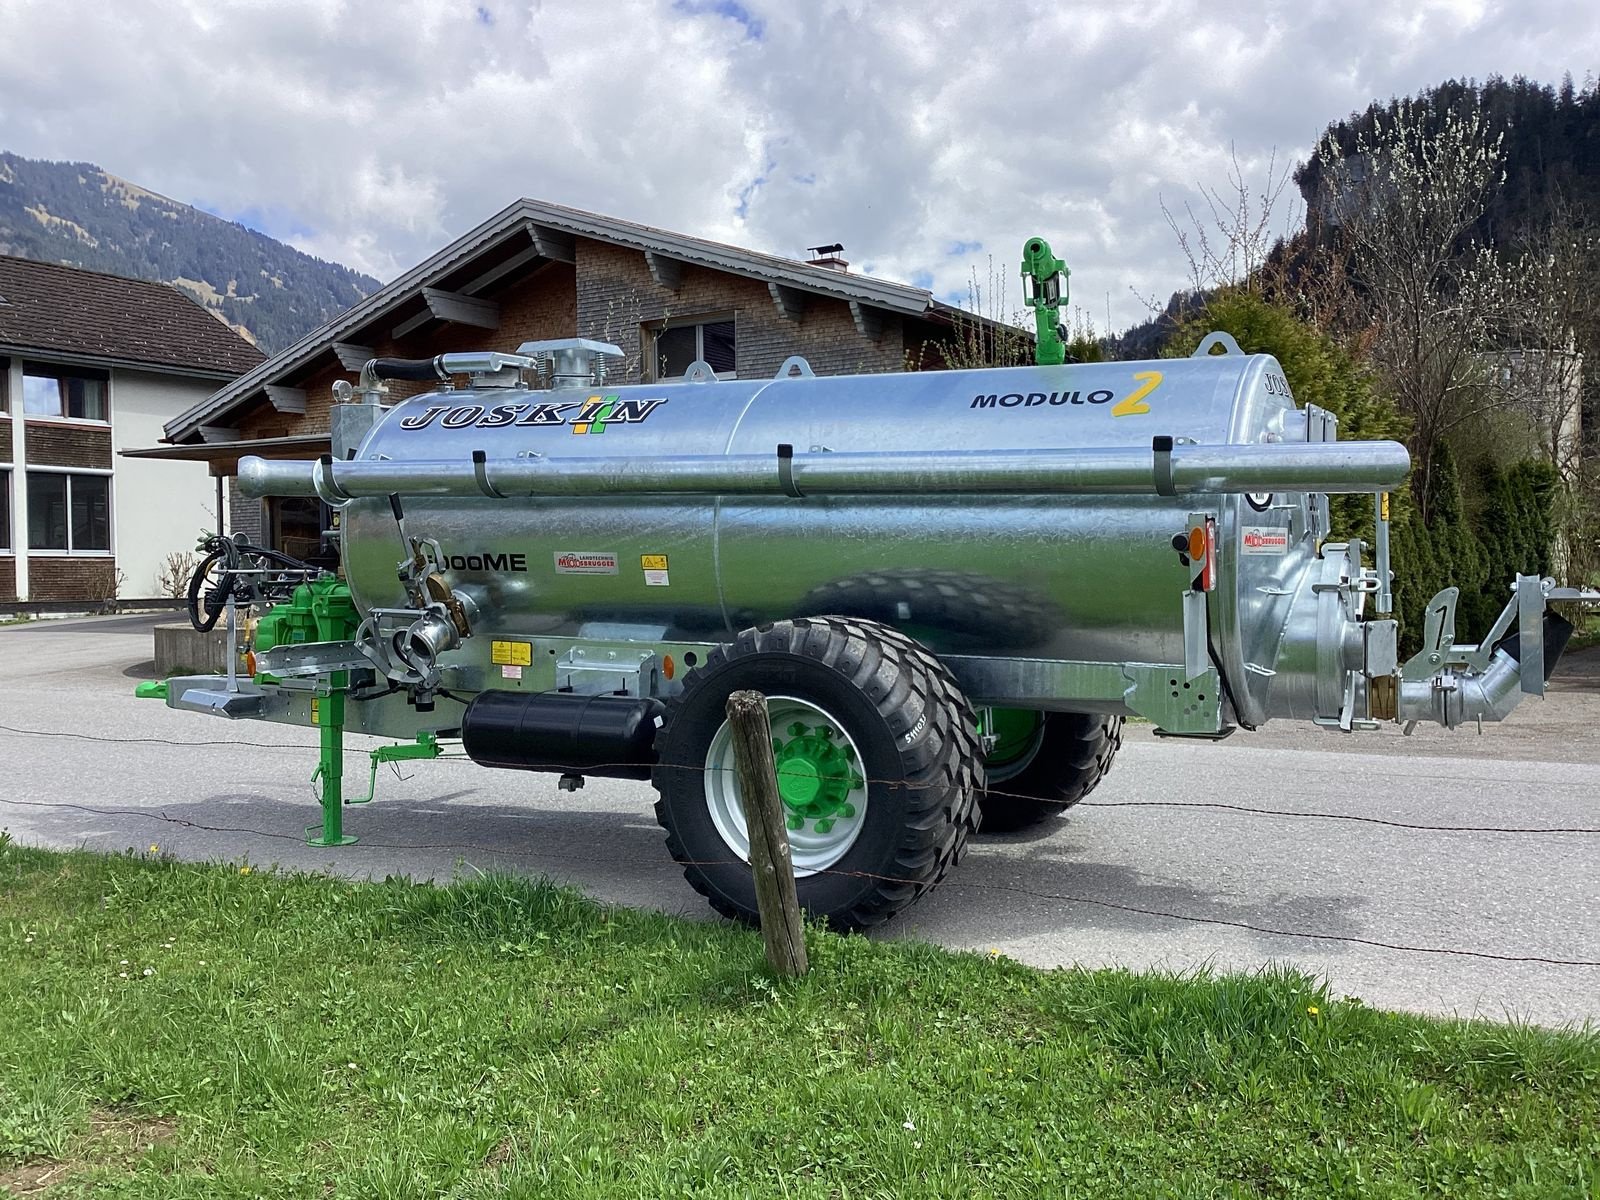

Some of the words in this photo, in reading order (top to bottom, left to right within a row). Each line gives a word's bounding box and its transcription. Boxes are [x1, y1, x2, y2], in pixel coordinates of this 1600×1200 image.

[970, 389, 1114, 409] MODULO
[1111, 371, 1164, 416] 2
[1264, 373, 1293, 399] JOS
[400, 398, 667, 429] JOSKIN
